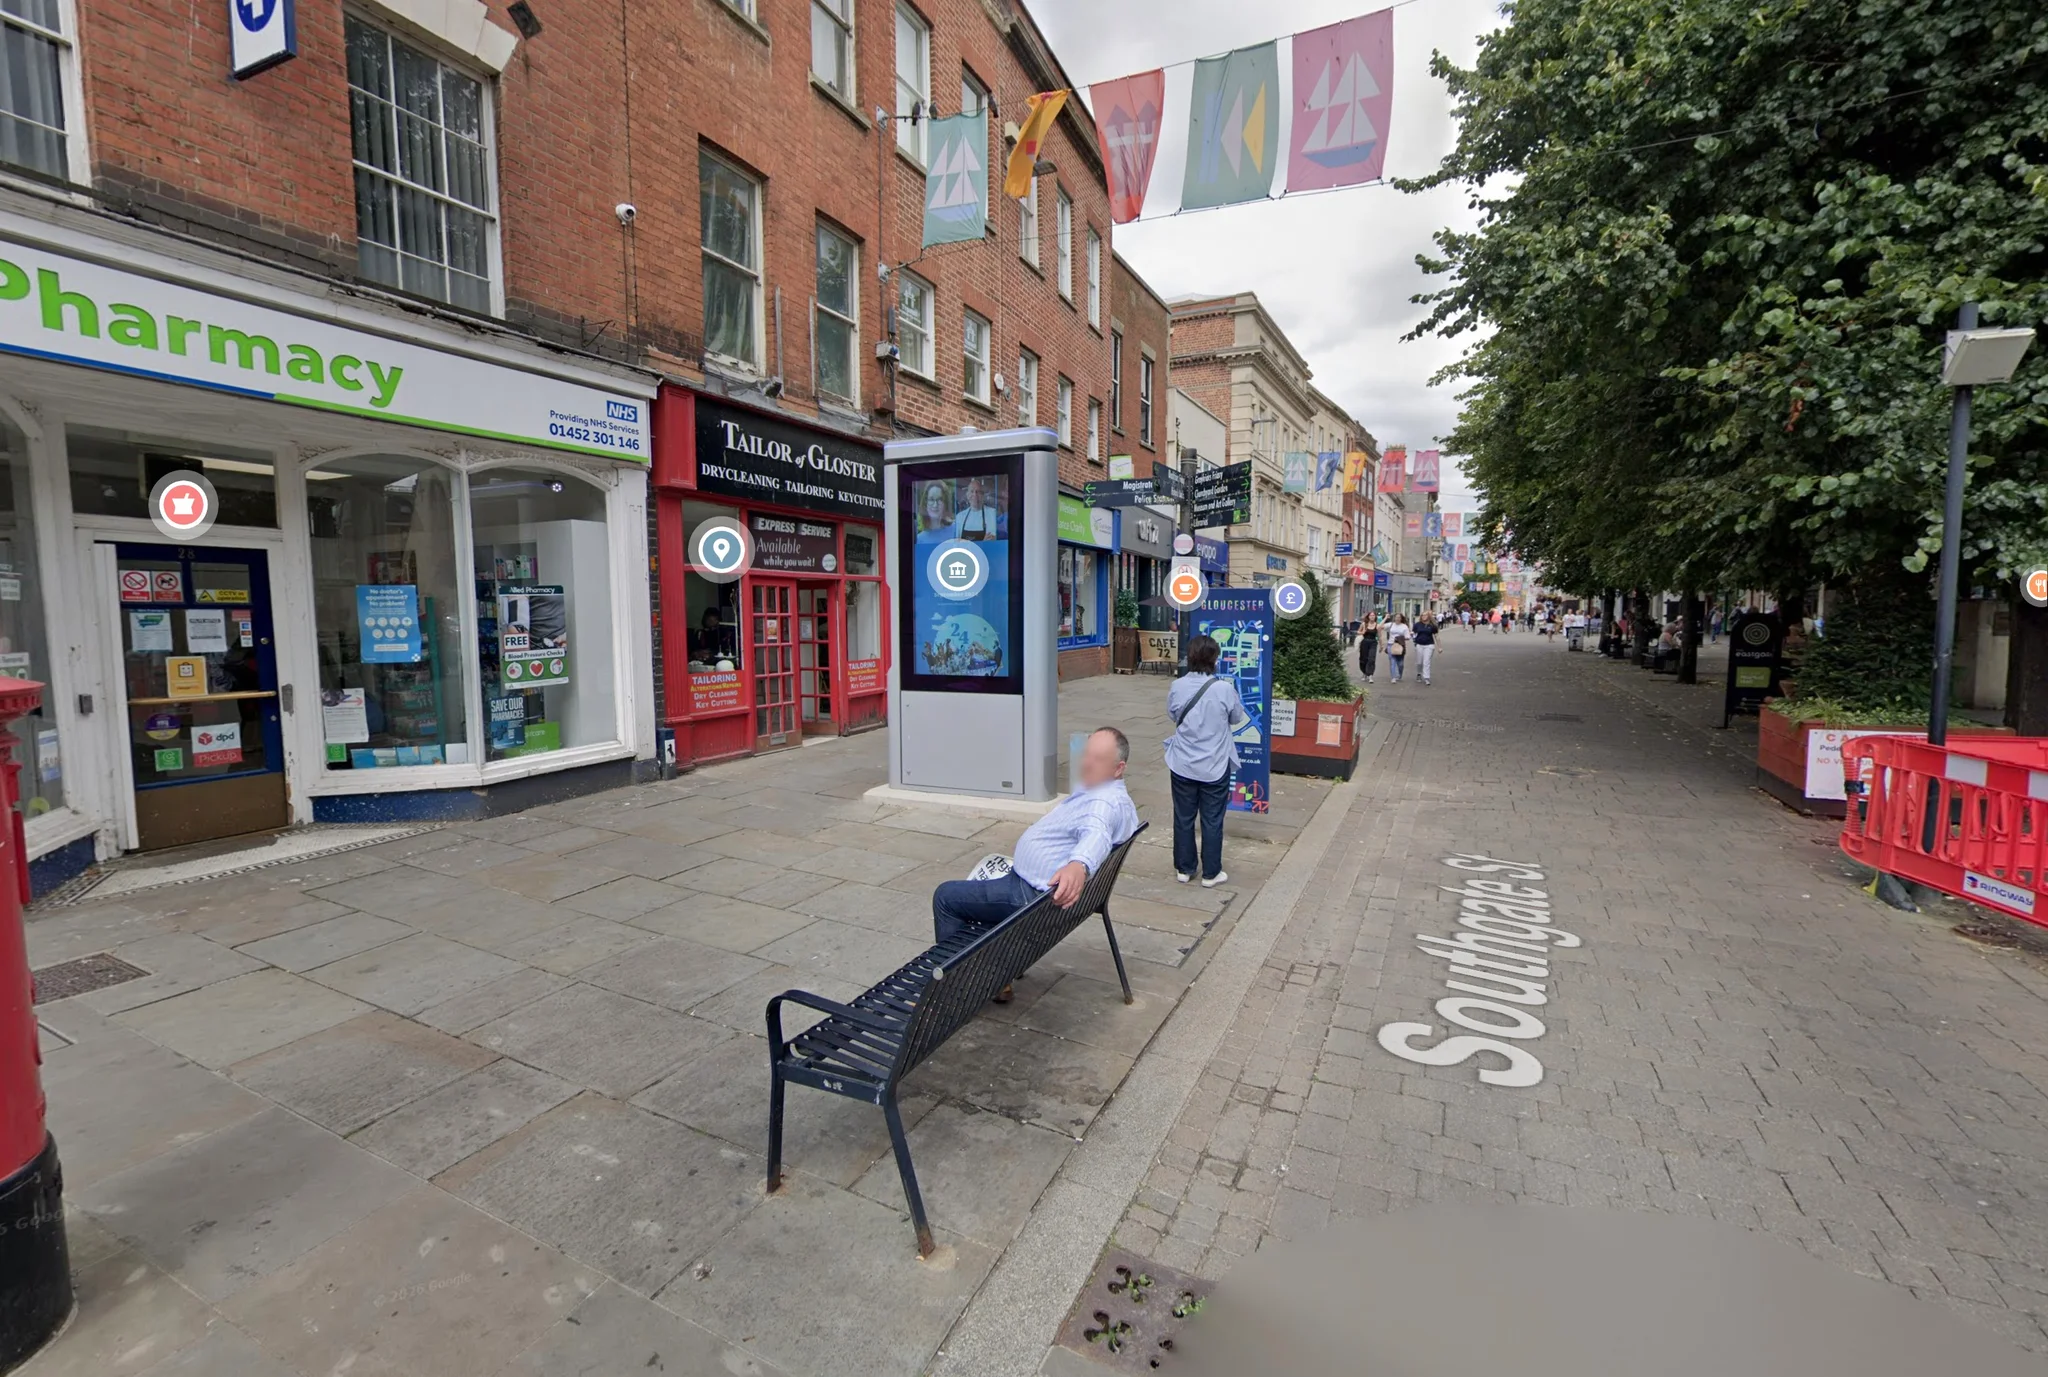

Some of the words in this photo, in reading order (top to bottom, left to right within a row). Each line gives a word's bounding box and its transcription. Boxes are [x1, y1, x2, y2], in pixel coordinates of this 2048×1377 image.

[608, 402, 636, 421] NHS
[549, 409, 589, 427] Providing
[590, 418, 607, 429] NHS
[608, 422, 640, 435] Services
[549, 423, 590, 442] 01452
[592, 431, 615, 446] 301
[618, 436, 640, 450] 146
[720, 419, 793, 463] TAILOR
[794, 454, 807, 468] of
[807, 444, 877, 483] GLOSTER
[701, 462, 780, 489] DRYCLEANING
[785, 480, 834, 500] TAILORING
[838, 490, 886, 509] KEYCUTTING
[1134, 494, 1152, 504] Police
[1222, 497, 1236, 508] Gallery
[758, 517, 796, 534] EXPRESS
[800, 523, 832, 538] SERVICE
[756, 537, 801, 555] Available
[178, 547, 195, 559] 28
[763, 556, 784, 567] while
[784, 559, 797, 568] you
[797, 556, 815, 567] wait!
[525, 586, 555, 594] Pharmacy
[1201, 599, 1264, 611] GLOUCESTER
[505, 635, 528, 647] FREE
[1148, 636, 1177, 649] CAFÉ
[1157, 648, 1171, 658] 72
[848, 661, 876, 670] TAILORING
[692, 673, 737, 685] TAILORING
[491, 699, 508, 713] SAVE
[508, 696, 524, 710] OUR
[711, 699, 737, 707] CUTTING
[491, 709, 525, 722] PHARMACIES
[216, 732, 235, 742] dpd
[199, 750, 238, 763] Pickup
[1980, 882, 2033, 906] RINGWAY
